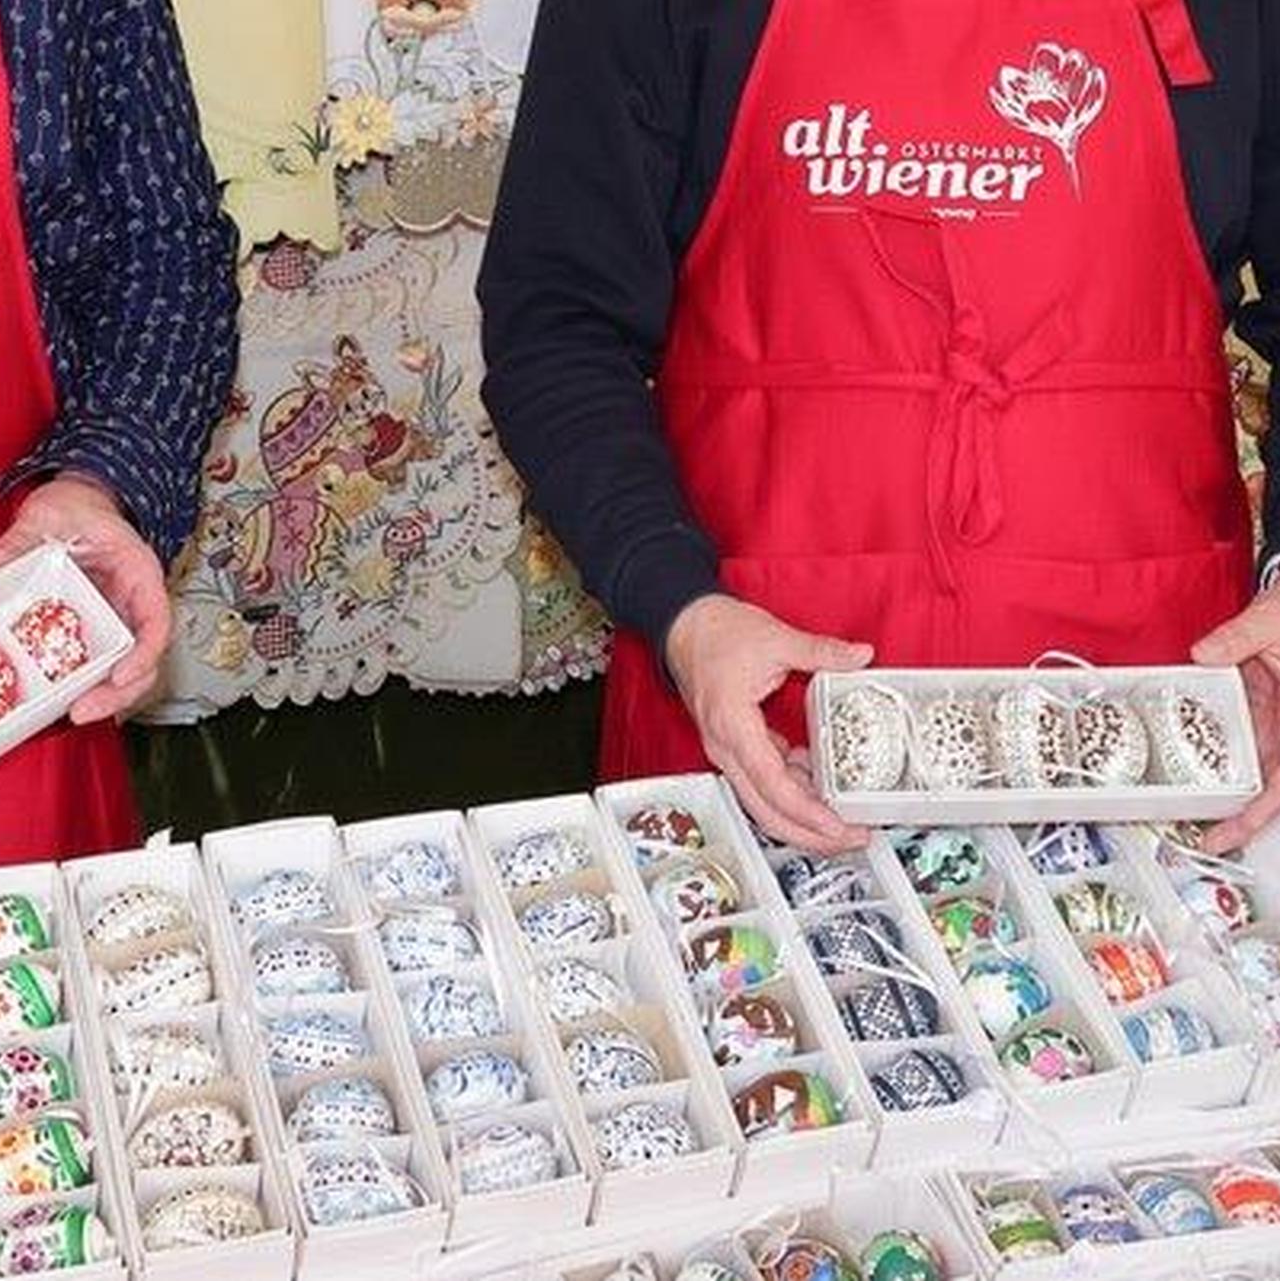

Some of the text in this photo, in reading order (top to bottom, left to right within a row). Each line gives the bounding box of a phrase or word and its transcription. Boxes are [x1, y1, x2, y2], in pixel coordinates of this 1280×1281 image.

[782, 103, 889, 157] alt.
[900, 141, 1043, 161] OSTERMARKT
[807, 157, 1045, 201] wiener
